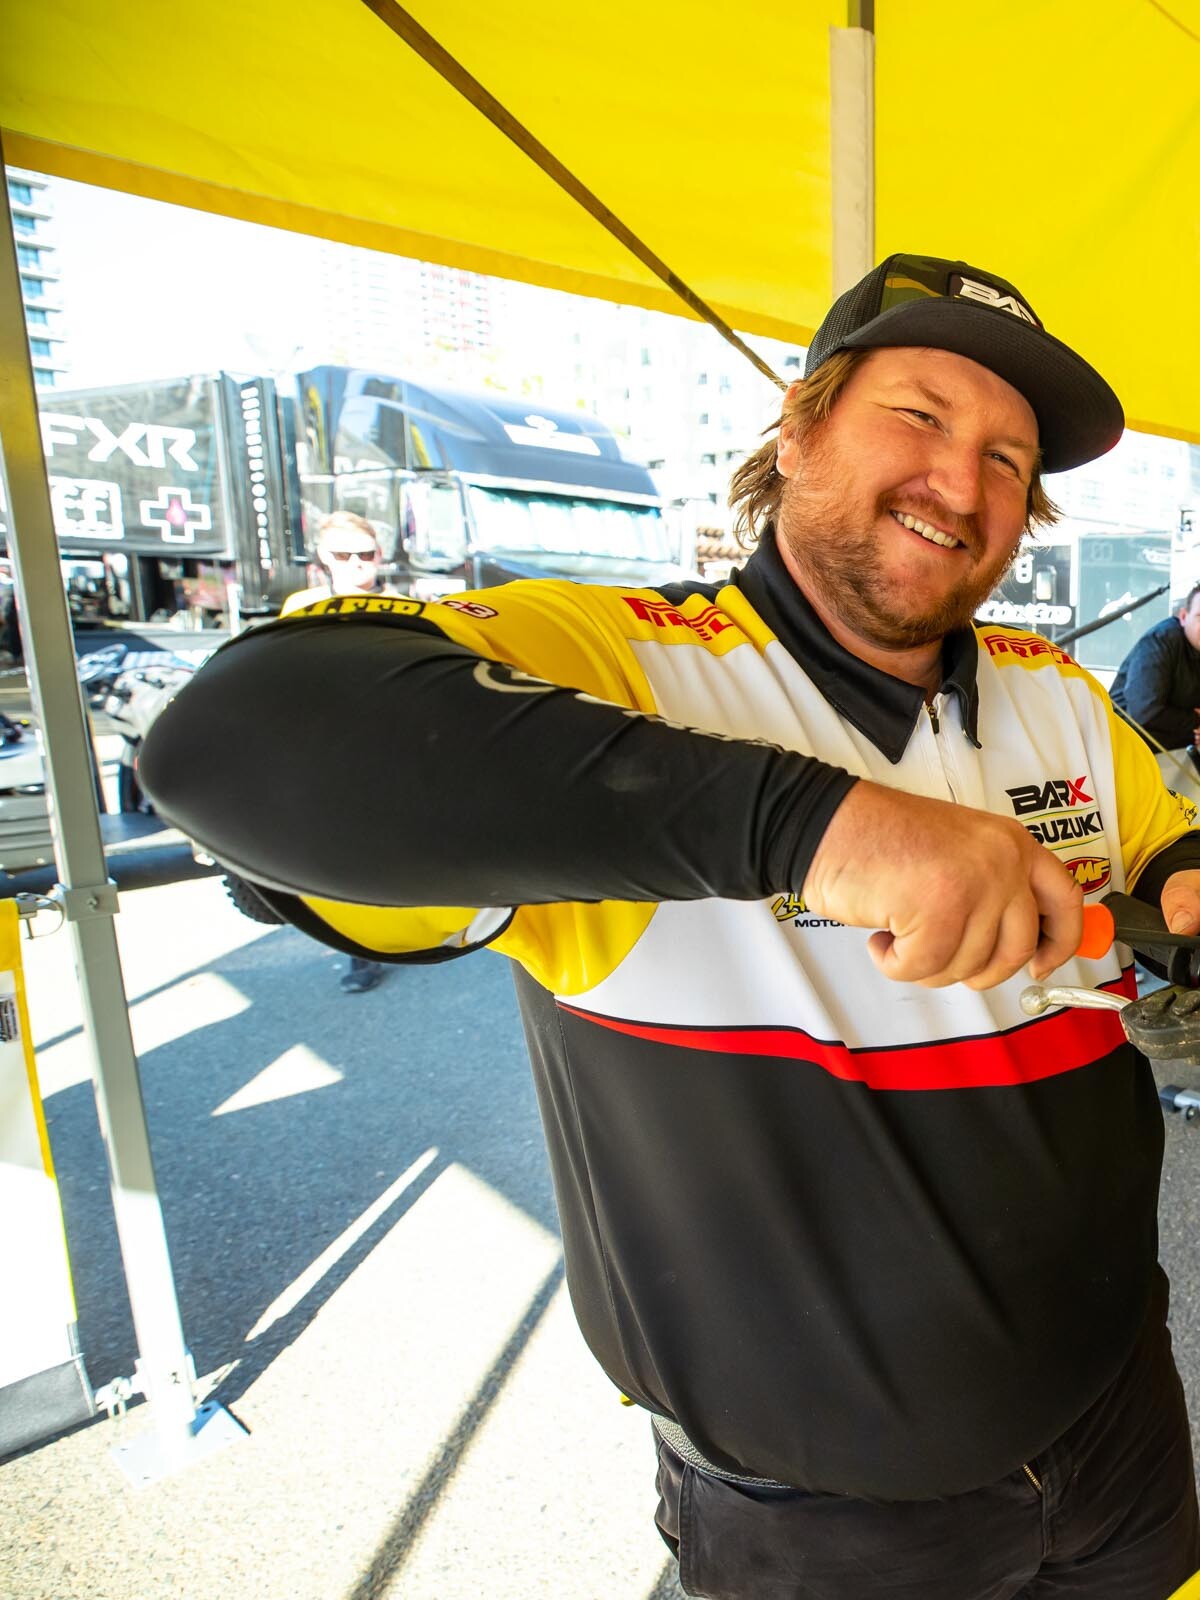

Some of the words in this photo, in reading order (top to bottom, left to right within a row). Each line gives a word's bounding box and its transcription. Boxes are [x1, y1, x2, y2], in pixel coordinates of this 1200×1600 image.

[38, 410, 200, 472] FXR
[1004, 775, 1095, 816] BARX
[1025, 811, 1105, 845] SUZUKI
[1067, 858, 1111, 886] MF
